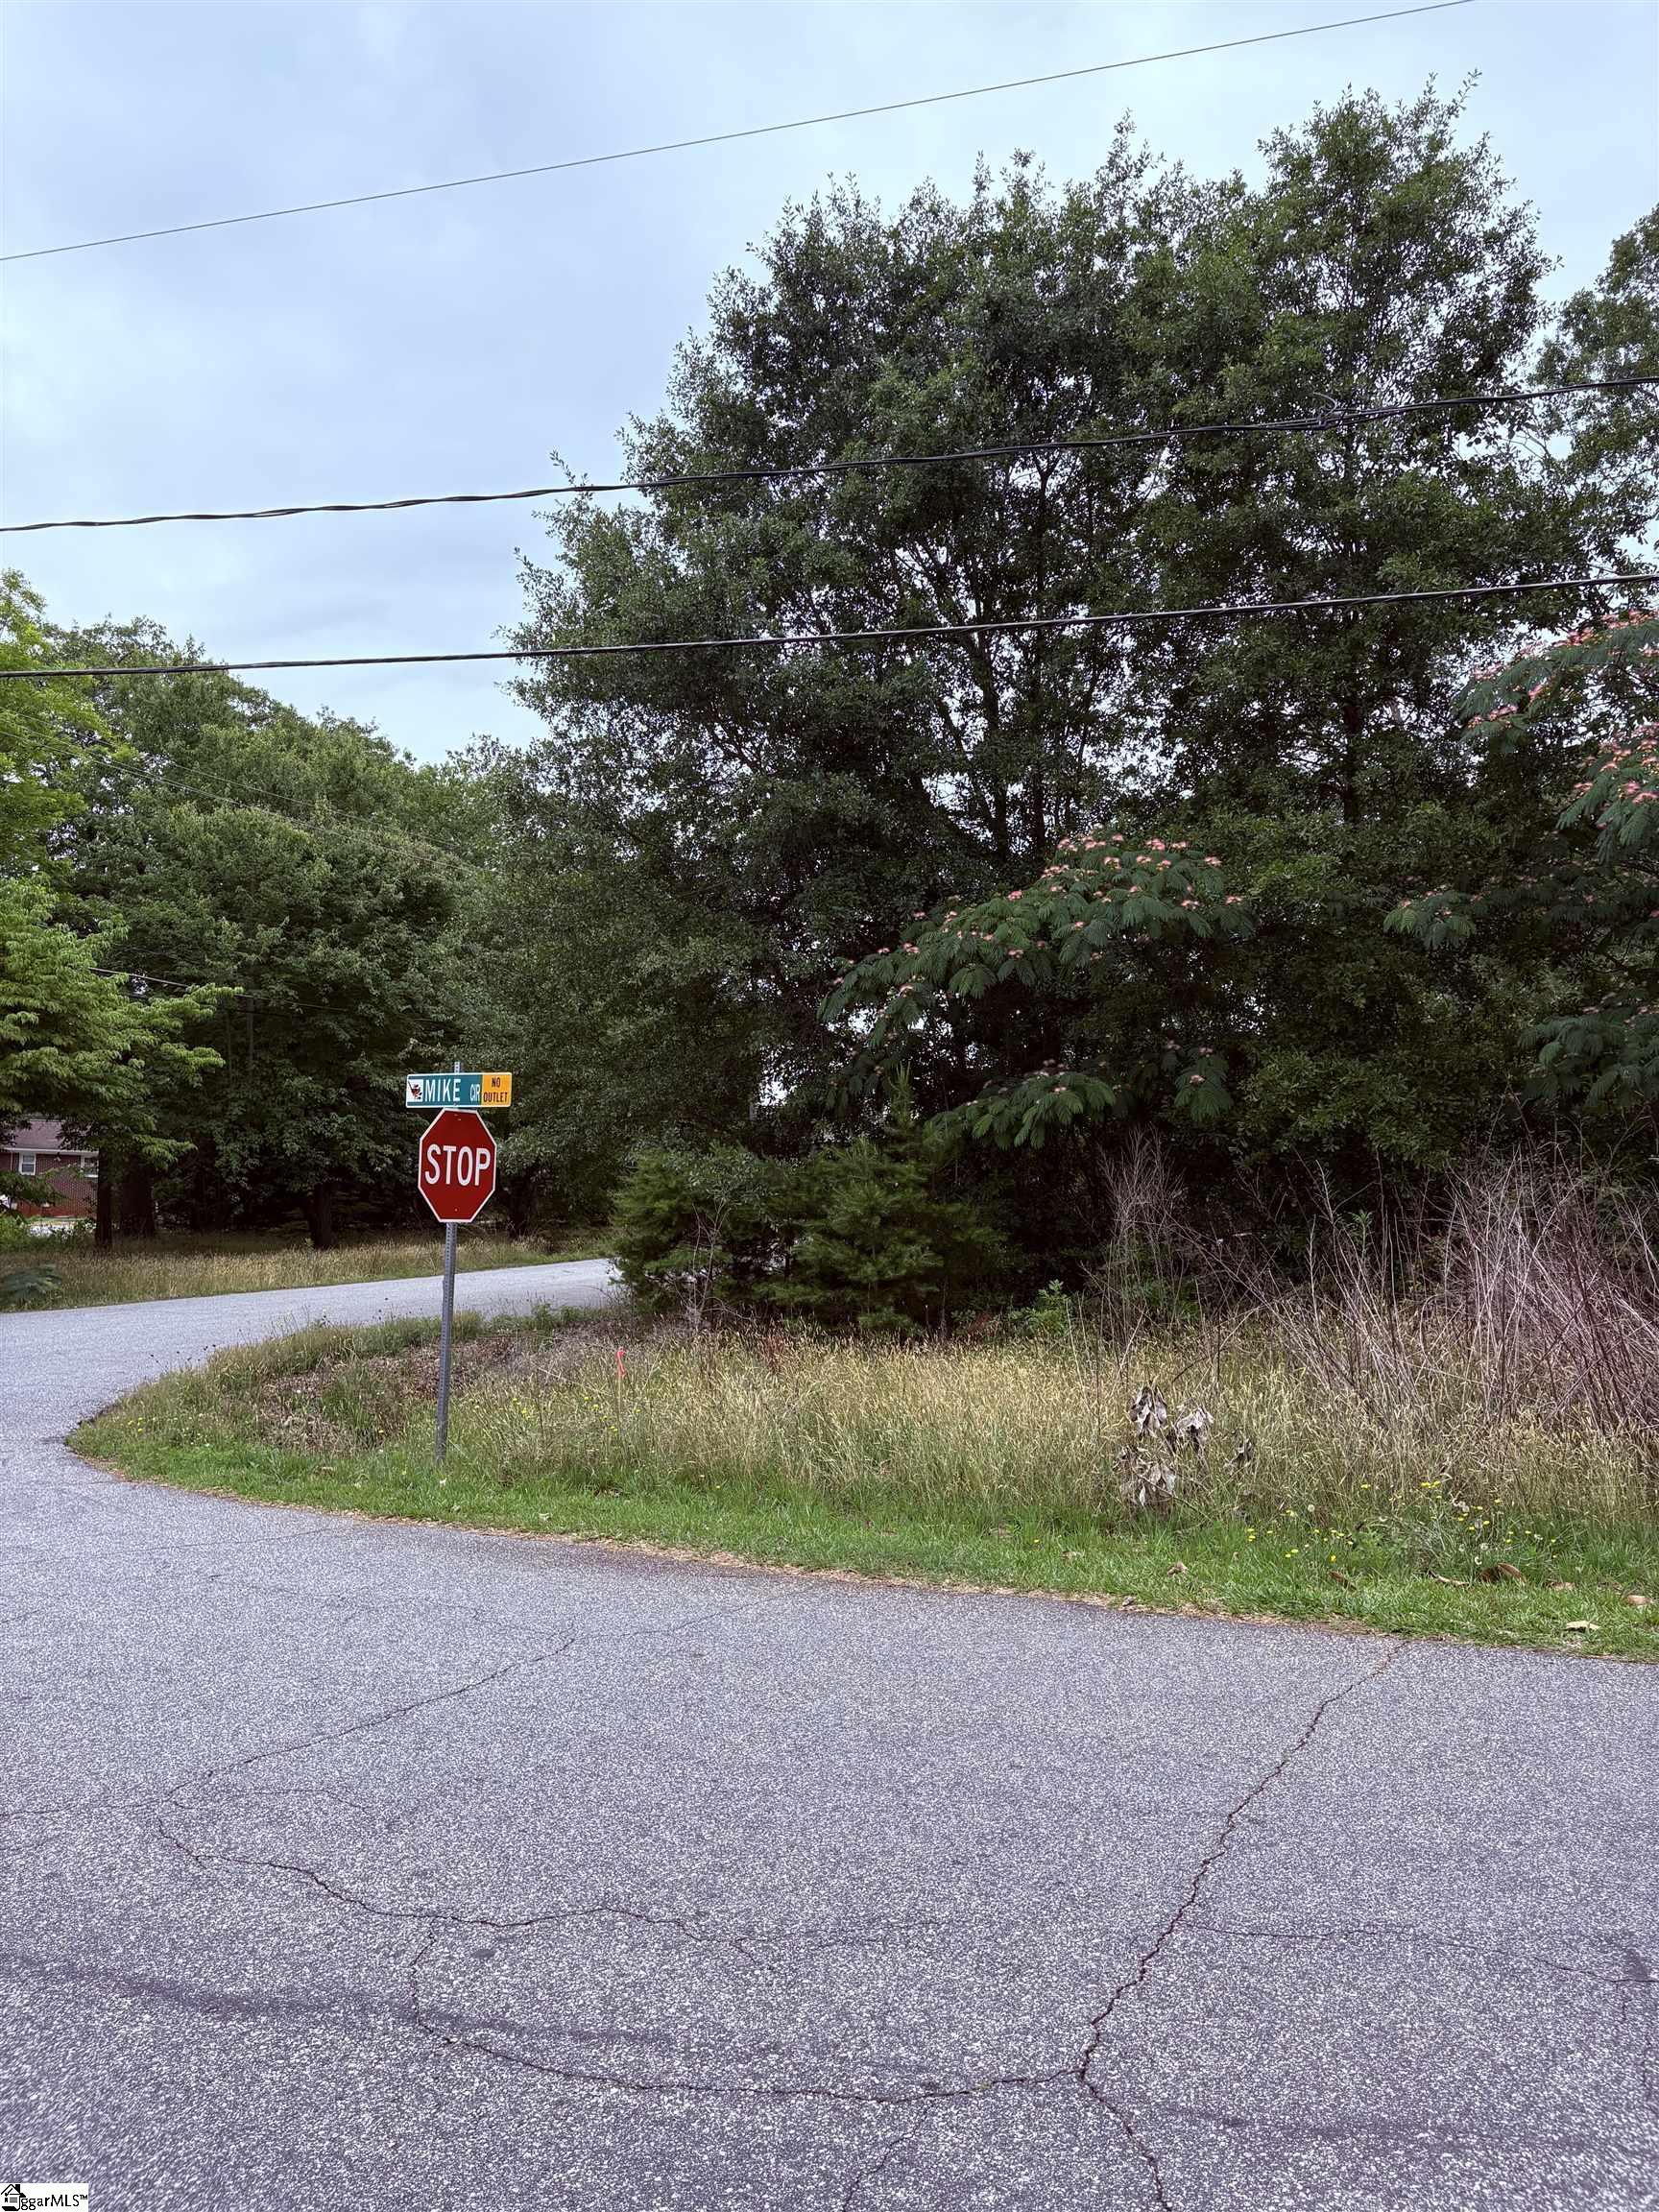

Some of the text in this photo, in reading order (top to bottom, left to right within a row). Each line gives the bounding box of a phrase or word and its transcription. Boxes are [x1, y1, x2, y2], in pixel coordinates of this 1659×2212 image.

[425, 1078, 461, 1102] MIKE
[492, 1077, 500, 1087] NO
[483, 1092, 508, 1102] OUTLET
[424, 1143, 491, 1186] STOP
